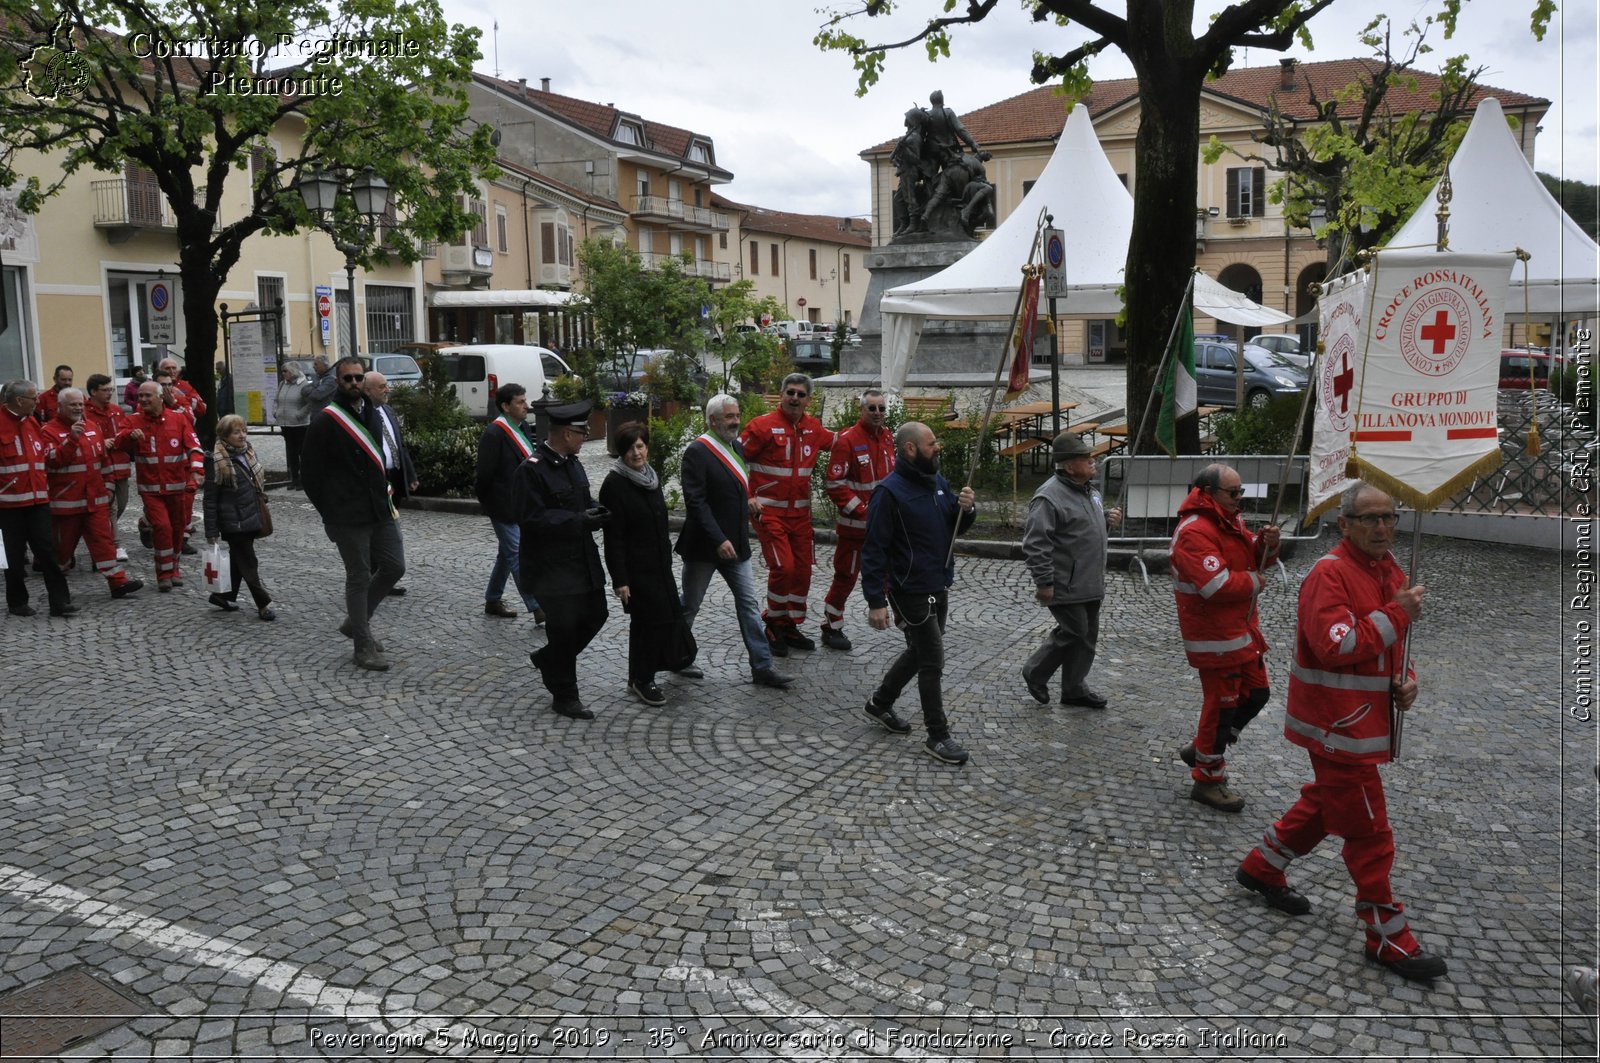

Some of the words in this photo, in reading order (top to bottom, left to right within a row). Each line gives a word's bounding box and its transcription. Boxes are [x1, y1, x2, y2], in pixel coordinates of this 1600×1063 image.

[319, 302, 330, 310] STOP
[1375, 285, 1412, 341] CROCE
[1413, 269, 1457, 290] ROSSA
[1459, 274, 1493, 339] ITALIANA
[1416, 299, 1428, 313] DI
[1428, 291, 1461, 310] GINEVRA
[1458, 306, 1467, 318] 22
[1402, 311, 1433, 372] CONVENZIONE
[1455, 320, 1469, 359] AGOSTO
[1391, 391, 1453, 407] GRUPPO
[1455, 391, 1468, 405] DI
[1353, 412, 1437, 428] VILLANOVA
[1439, 410, 1494, 426] MONDOVI'
